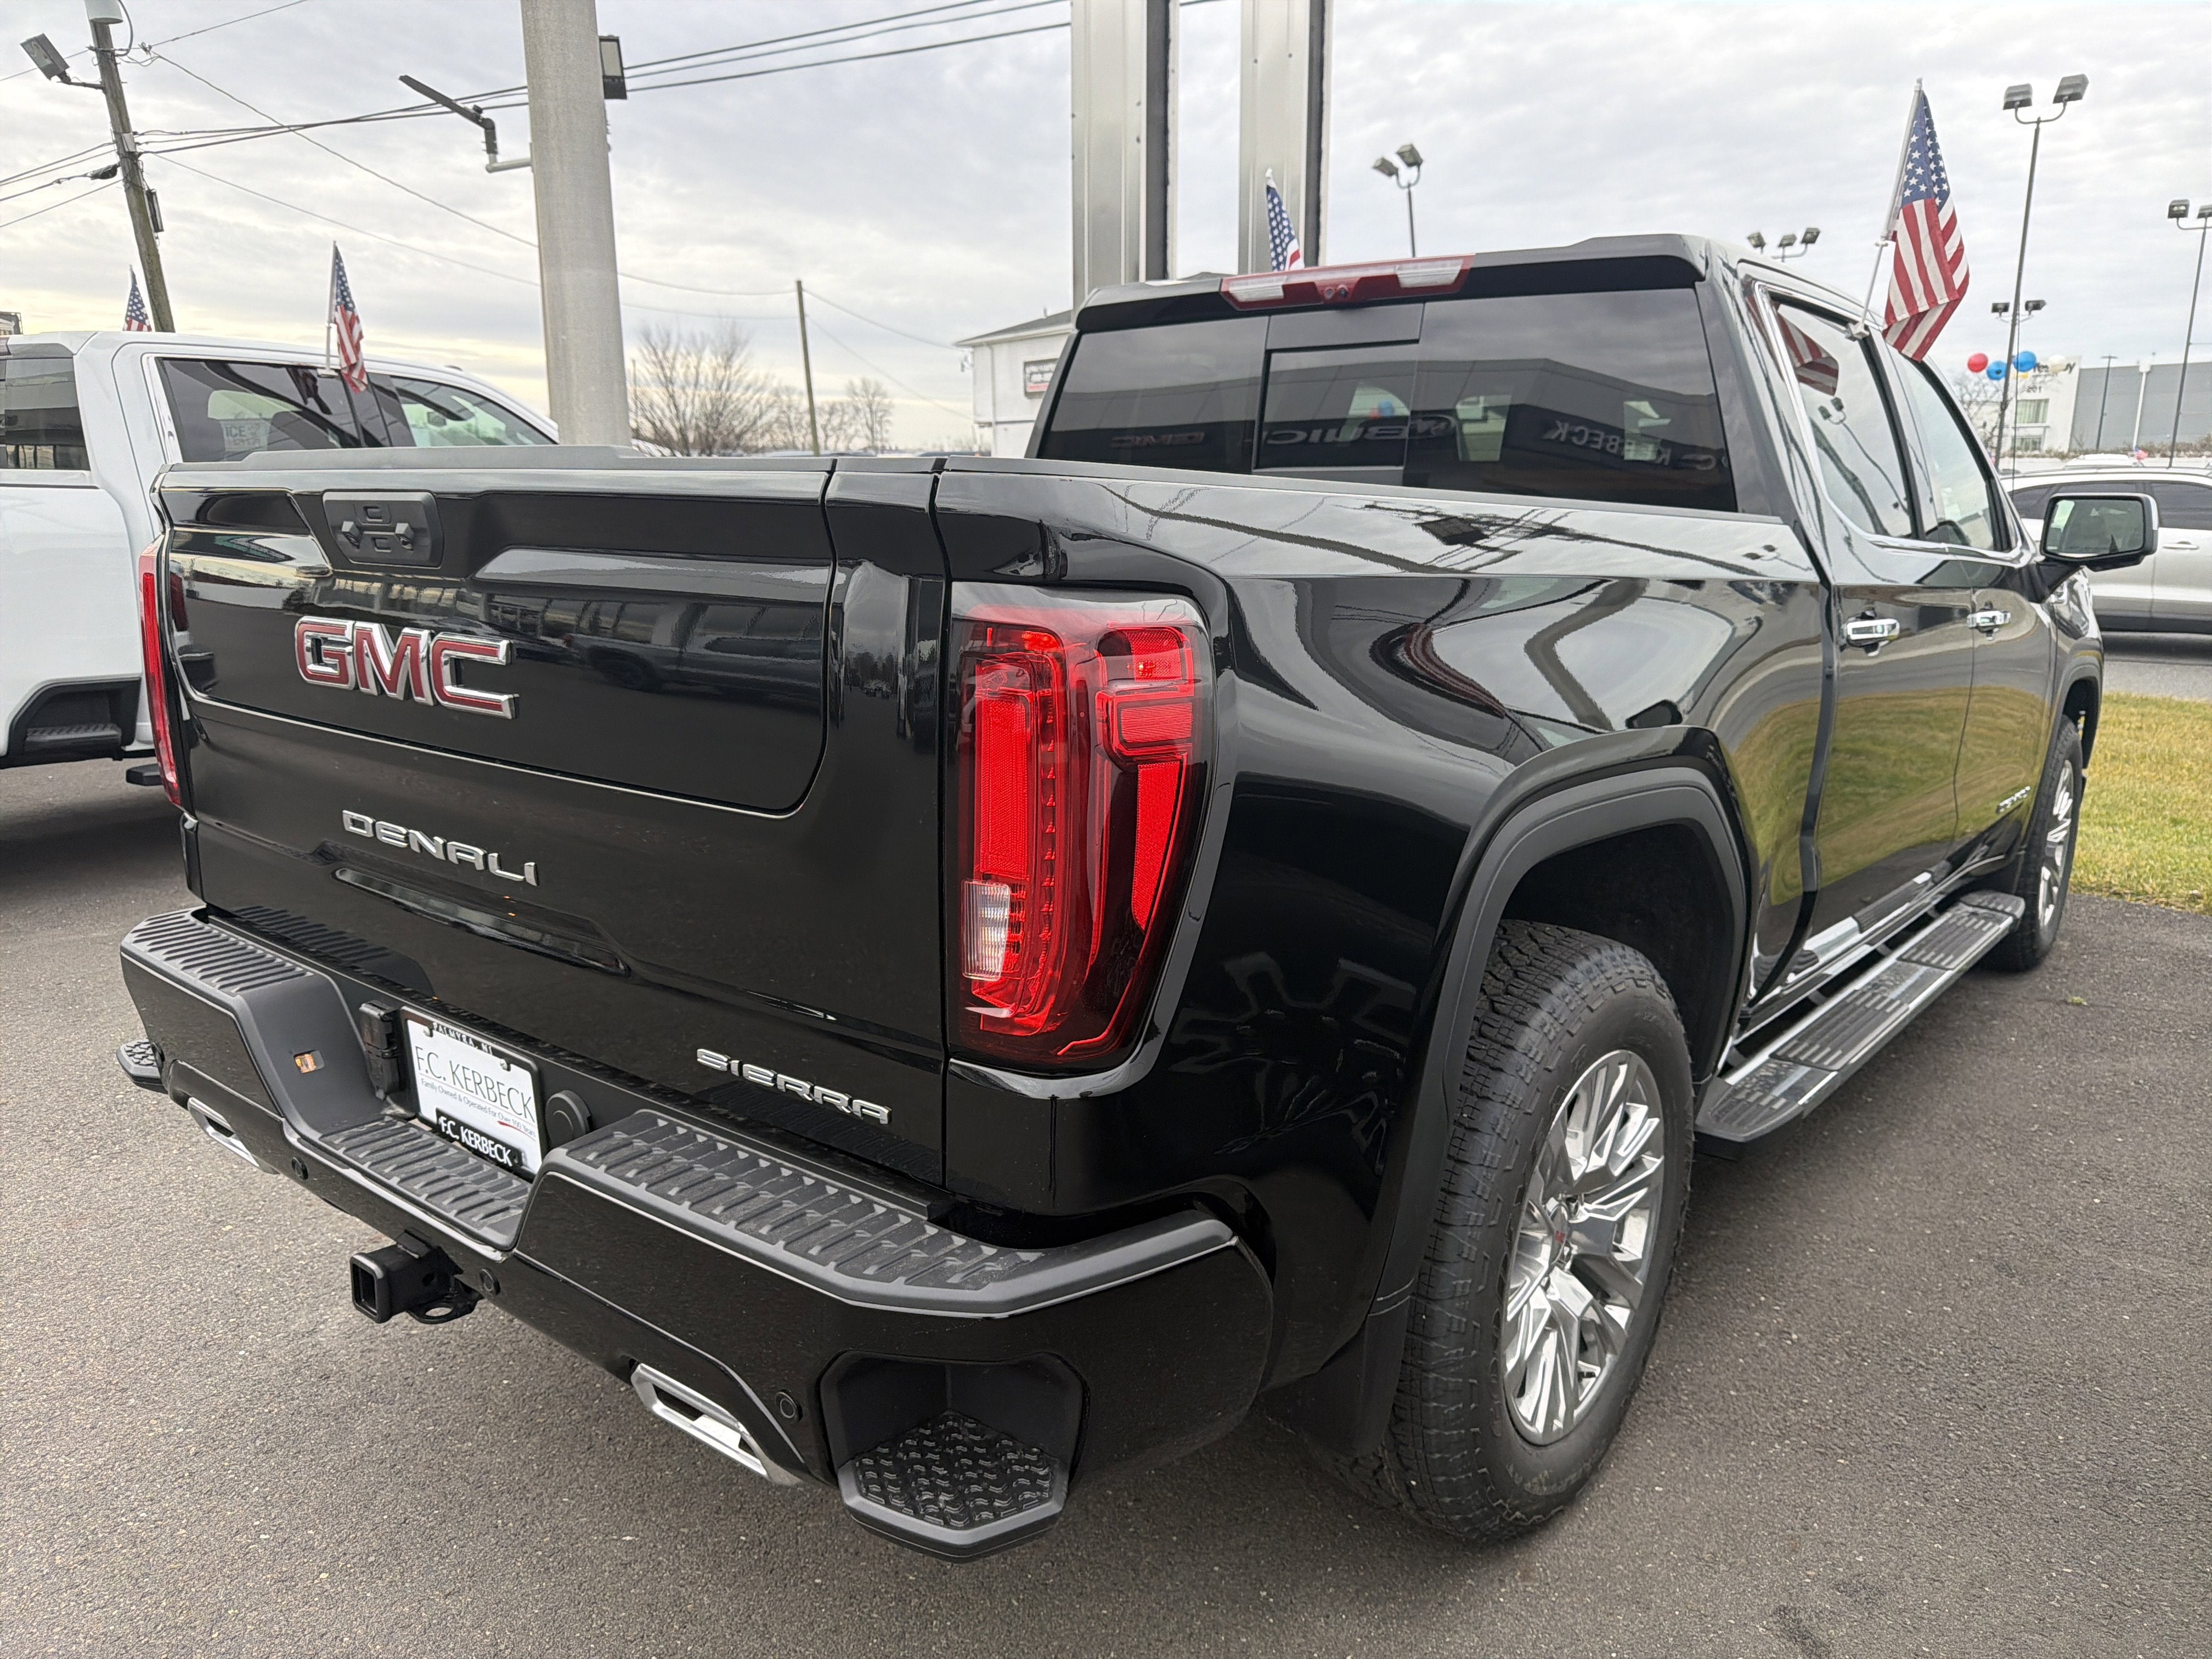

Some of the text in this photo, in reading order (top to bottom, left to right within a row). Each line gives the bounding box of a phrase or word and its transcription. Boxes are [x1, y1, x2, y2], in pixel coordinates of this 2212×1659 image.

[295, 616, 518, 720] GMC
[342, 810, 538, 887] DENALI
[415, 1046, 536, 1124] F.C. KERBECK
[696, 1048, 892, 1125] SIERRA
[439, 1116, 513, 1167] F.C. KERBECK
